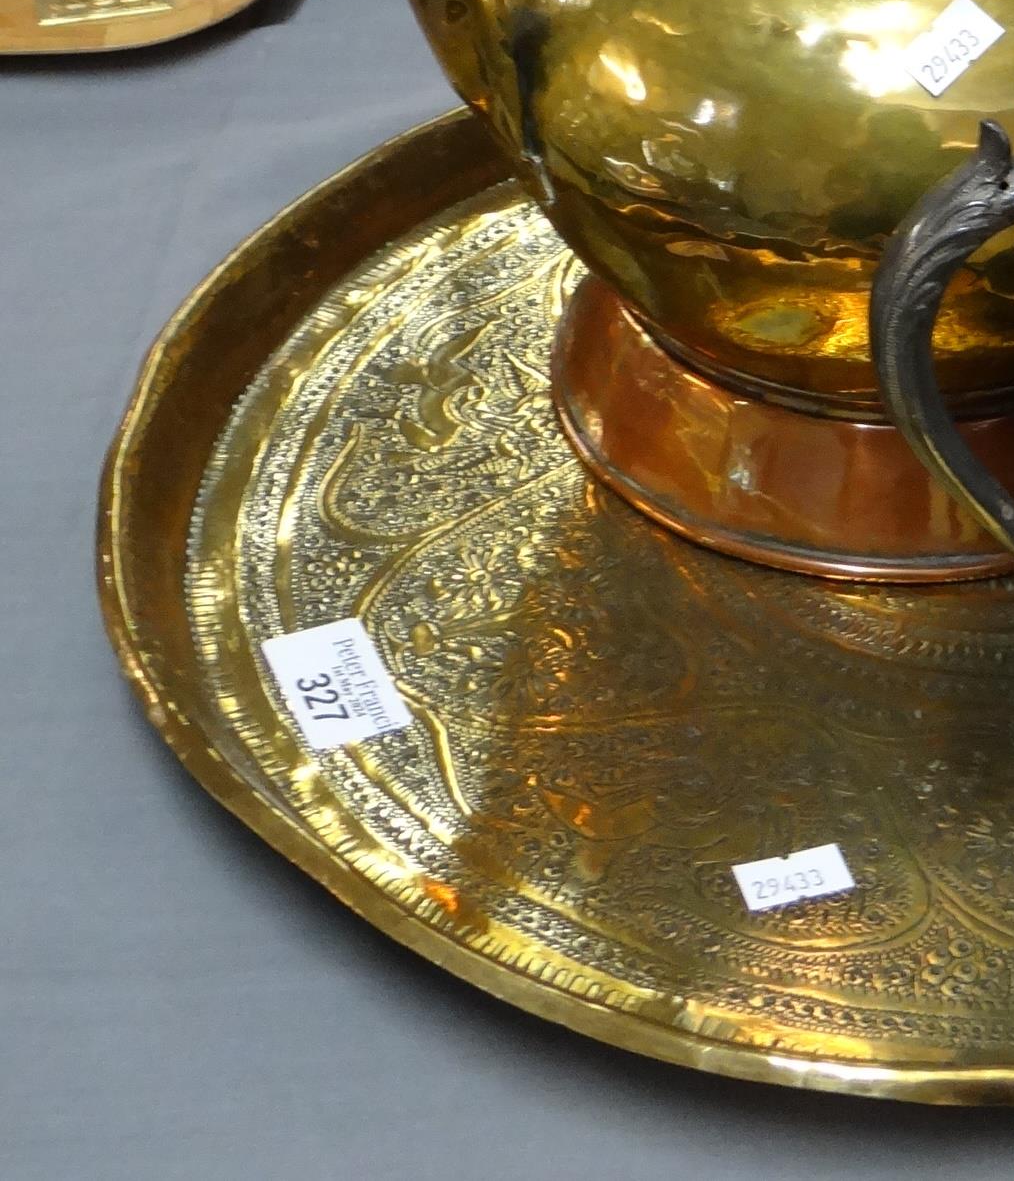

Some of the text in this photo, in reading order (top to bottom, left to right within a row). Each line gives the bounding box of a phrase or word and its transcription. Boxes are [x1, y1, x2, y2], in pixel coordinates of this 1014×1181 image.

[921, 29, 979, 83] 29433
[331, 637, 367, 677] Peter
[296, 672, 351, 720] 327
[751, 868, 825, 900] 29433
